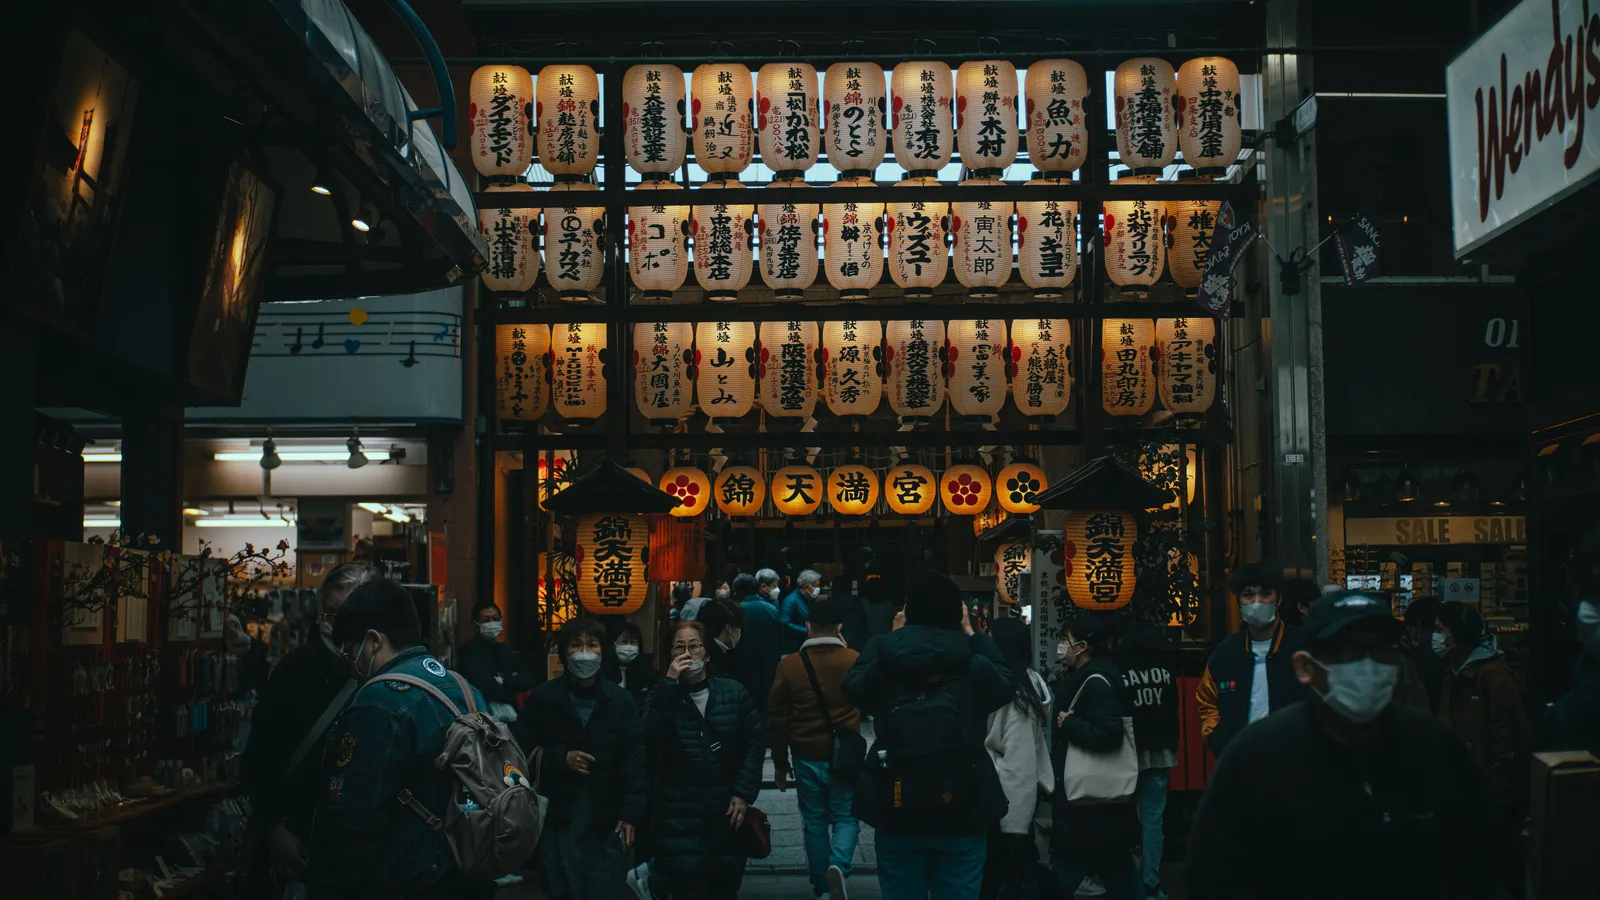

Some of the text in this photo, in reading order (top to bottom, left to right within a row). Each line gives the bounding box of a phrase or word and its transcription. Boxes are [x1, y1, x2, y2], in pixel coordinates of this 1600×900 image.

[558, 74, 574, 98] 献燈
[717, 71, 733, 95] 献燈
[788, 68, 804, 91] 献燈
[846, 68, 862, 91] 献燈
[920, 70, 935, 94] 献燈
[983, 65, 998, 88] 献燈
[1140, 64, 1156, 87] 献燈
[488, 72, 515, 167] 献燈 ダイヤモンド
[641, 71, 667, 163] 献燈 大岩建設工業
[867, 97, 877, 147] 川魚専門店
[1045, 71, 1073, 159] 献燈 魚力
[1197, 64, 1224, 159] 献燈 中央信用金庫
[1223, 90, 1234, 118] 京都
[843, 106, 865, 157] のとよ
[492, 218, 518, 279] 山本清掃
[581, 228, 593, 268] 株式会社
[861, 223, 872, 271] 京つけもの
[905, 213, 932, 278] ウィズユー
[974, 216, 996, 277] 寅太郎
[1127, 210, 1151, 276] 北村クリニック
[512, 328, 527, 351] 献燈
[710, 349, 738, 405] 山とみ
[838, 345, 860, 404] 源久秀
[1115, 323, 1139, 407] 献燈 田丸印房
[1396, 518, 1450, 545] SALE
[593, 516, 633, 608] 錦天満宮
[1085, 513, 1125, 604] 錦天満宮
[1133, 687, 1163, 707] JOY
